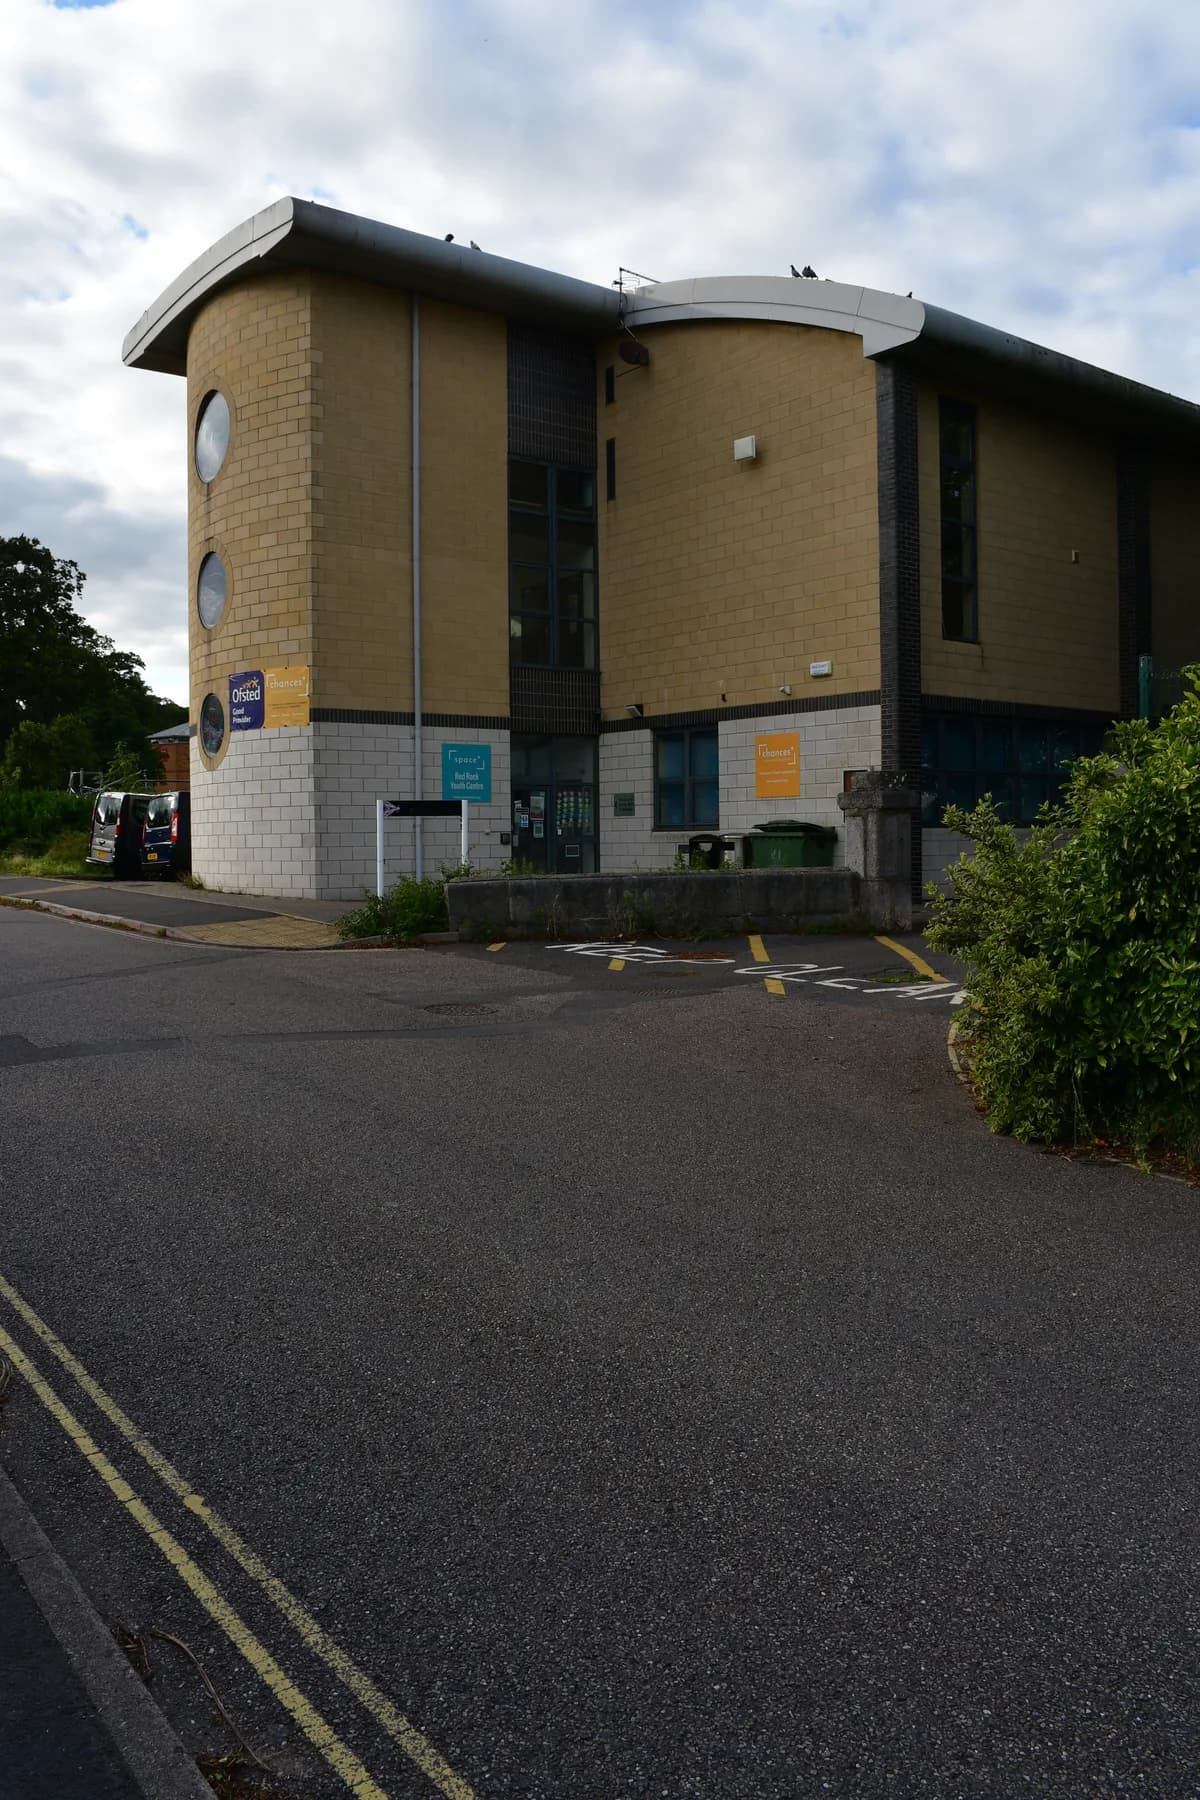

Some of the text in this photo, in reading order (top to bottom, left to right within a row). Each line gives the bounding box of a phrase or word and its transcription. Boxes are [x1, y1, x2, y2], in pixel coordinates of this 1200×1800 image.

[232, 686, 261, 703] Ofsted
[232, 707, 245, 716] Good
[454, 757, 477, 765] space
[544, 941, 736, 965] KEEP
